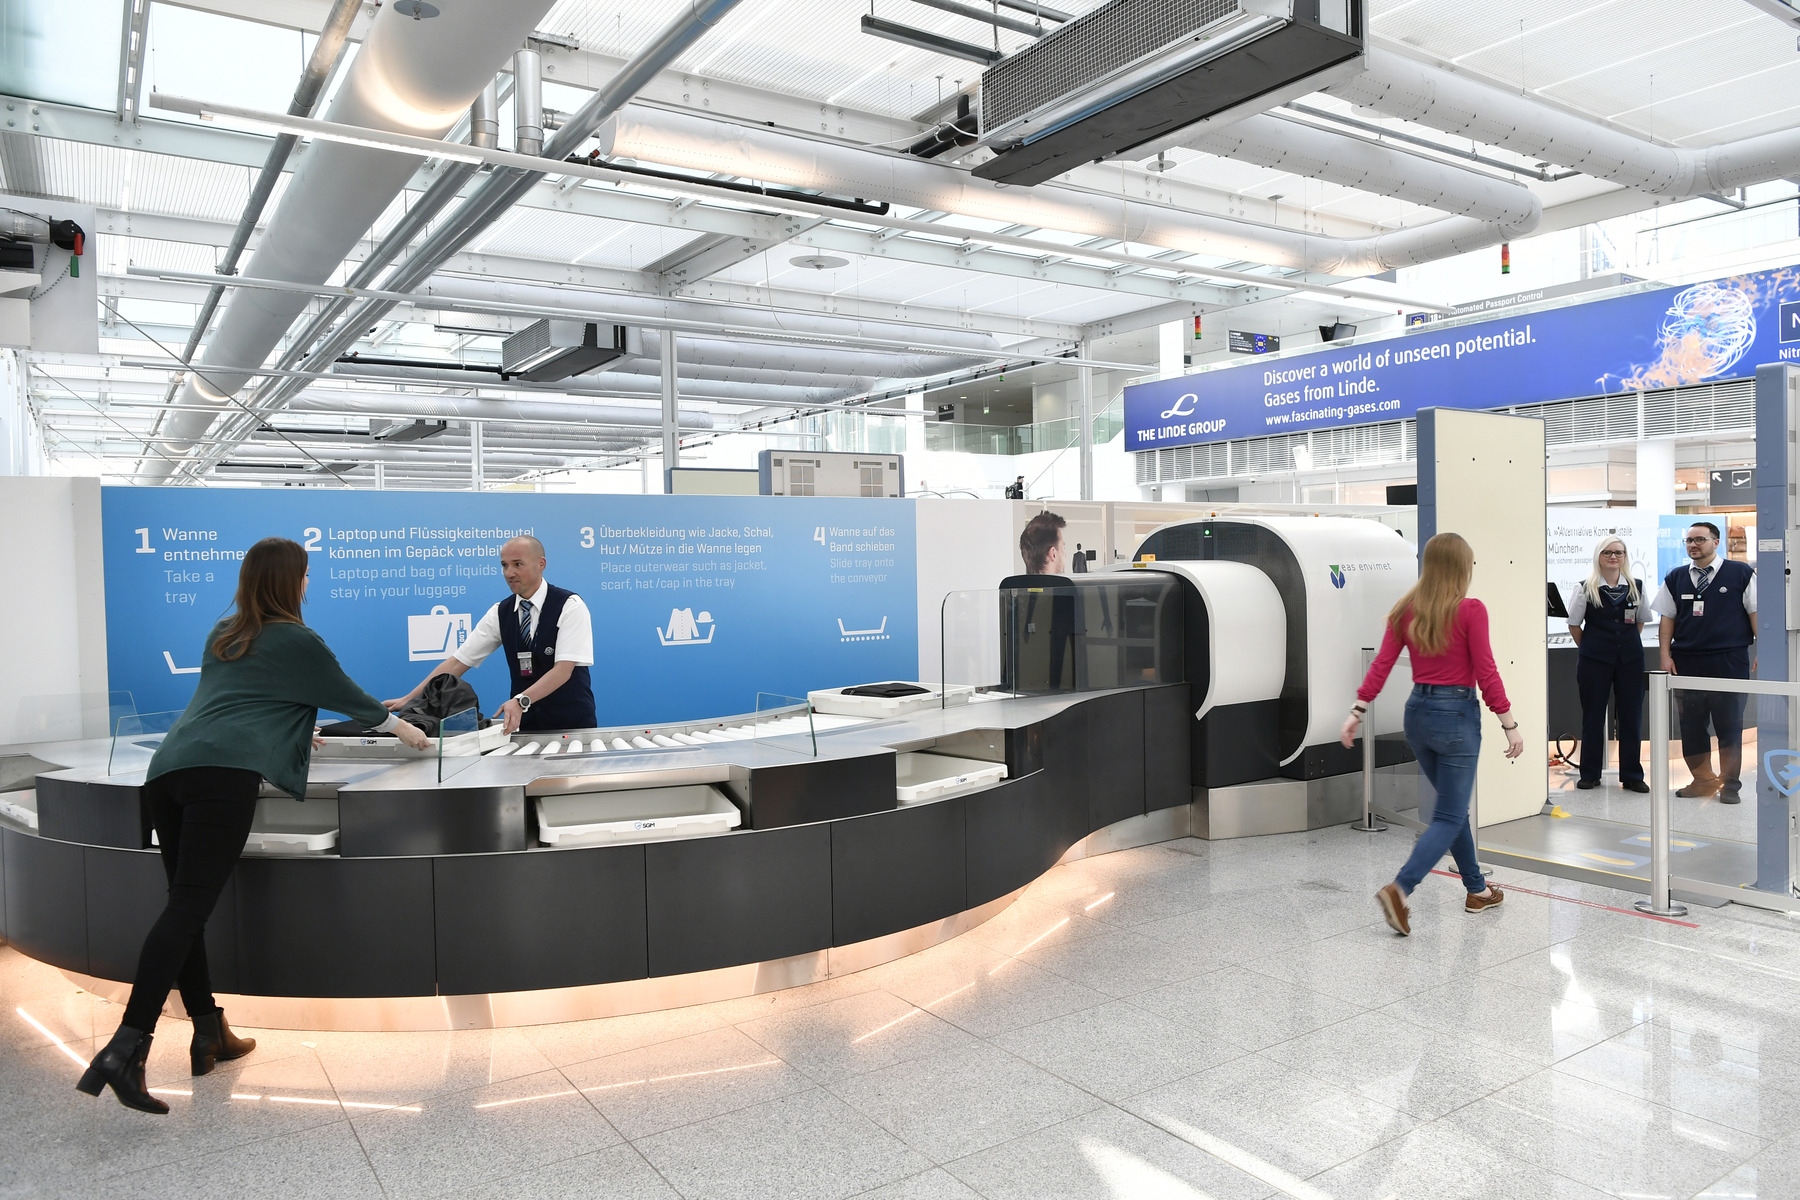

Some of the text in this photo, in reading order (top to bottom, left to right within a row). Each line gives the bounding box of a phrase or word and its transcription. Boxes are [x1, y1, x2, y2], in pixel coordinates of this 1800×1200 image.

[1485, 296, 1516, 308] Passport
[1517, 291, 1544, 303] Control
[1263, 324, 1537, 386] Discover a world of unseen potential.
[1264, 376, 1380, 407] Gases from Linde.
[1265, 399, 1401, 425] www.fascinating-gases.com
[1137, 418, 1226, 442] THE LINDE GROUP
[162, 528, 218, 541] Wanne
[329, 527, 534, 543] Laptop und Flüssigkeitenbeutel
[580, 526, 595, 549] 3
[600, 524, 774, 540] Überbekleidung wie Jacke, Schal,
[813, 526, 826, 546] 4
[829, 526, 895, 537] Wanne auf das
[134, 527, 156, 554] 1
[303, 527, 323, 552] 2
[830, 541, 895, 552] Band schieben
[163, 547, 248, 561] entnehme
[329, 546, 381, 559] können
[384, 545, 402, 558] im
[406, 545, 455, 560] Gepäck
[600, 543, 621, 555] Hut
[629, 543, 663, 554] Mütze
[665, 543, 675, 554] in
[678, 543, 694, 554] die
[697, 543, 732, 554] Wanne
[734, 542, 762, 556] legen
[601, 560, 767, 573] Place outerwear such as jacket,
[830, 557, 894, 570] Slide tray onto
[1341, 562, 1392, 571] eas envimet
[164, 569, 214, 583] Take a
[330, 567, 378, 582] Laptop
[381, 565, 406, 578] and
[411, 565, 435, 580] bag
[439, 564, 452, 577] of
[456, 564, 497, 579] liquids
[830, 573, 888, 584] the conveyor
[601, 578, 633, 590] scarf,
[635, 578, 654, 589] hat
[682, 577, 693, 588] in
[695, 577, 712, 588] the
[715, 577, 736, 589] tray
[165, 591, 197, 606] tray
[330, 584, 467, 600] stay in your luggage
